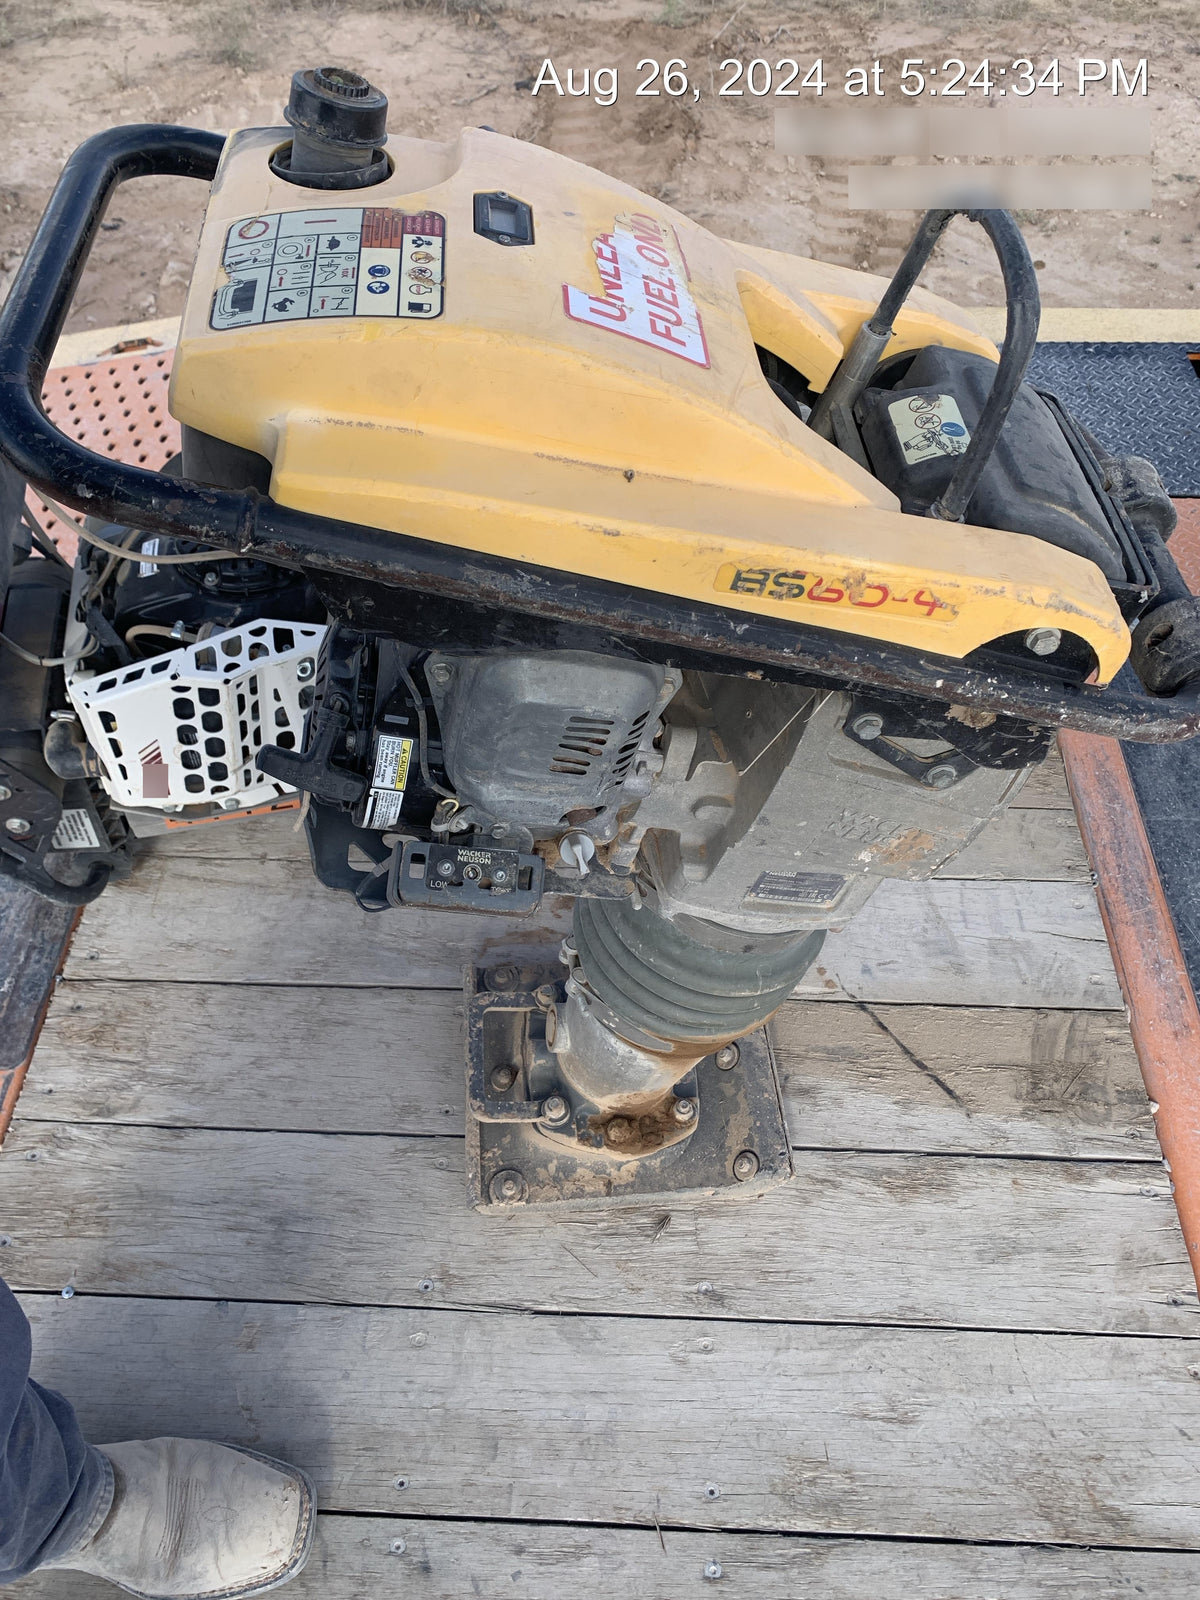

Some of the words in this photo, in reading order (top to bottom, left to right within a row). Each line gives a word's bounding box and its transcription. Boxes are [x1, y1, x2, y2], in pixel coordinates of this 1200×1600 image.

[588, 232, 627, 322] UNLEA
[641, 273, 687, 348] FUEL
[397, 755, 408, 784] CAUTION
[457, 848, 492, 859] WACKER
[457, 855, 492, 865] NEUSON
